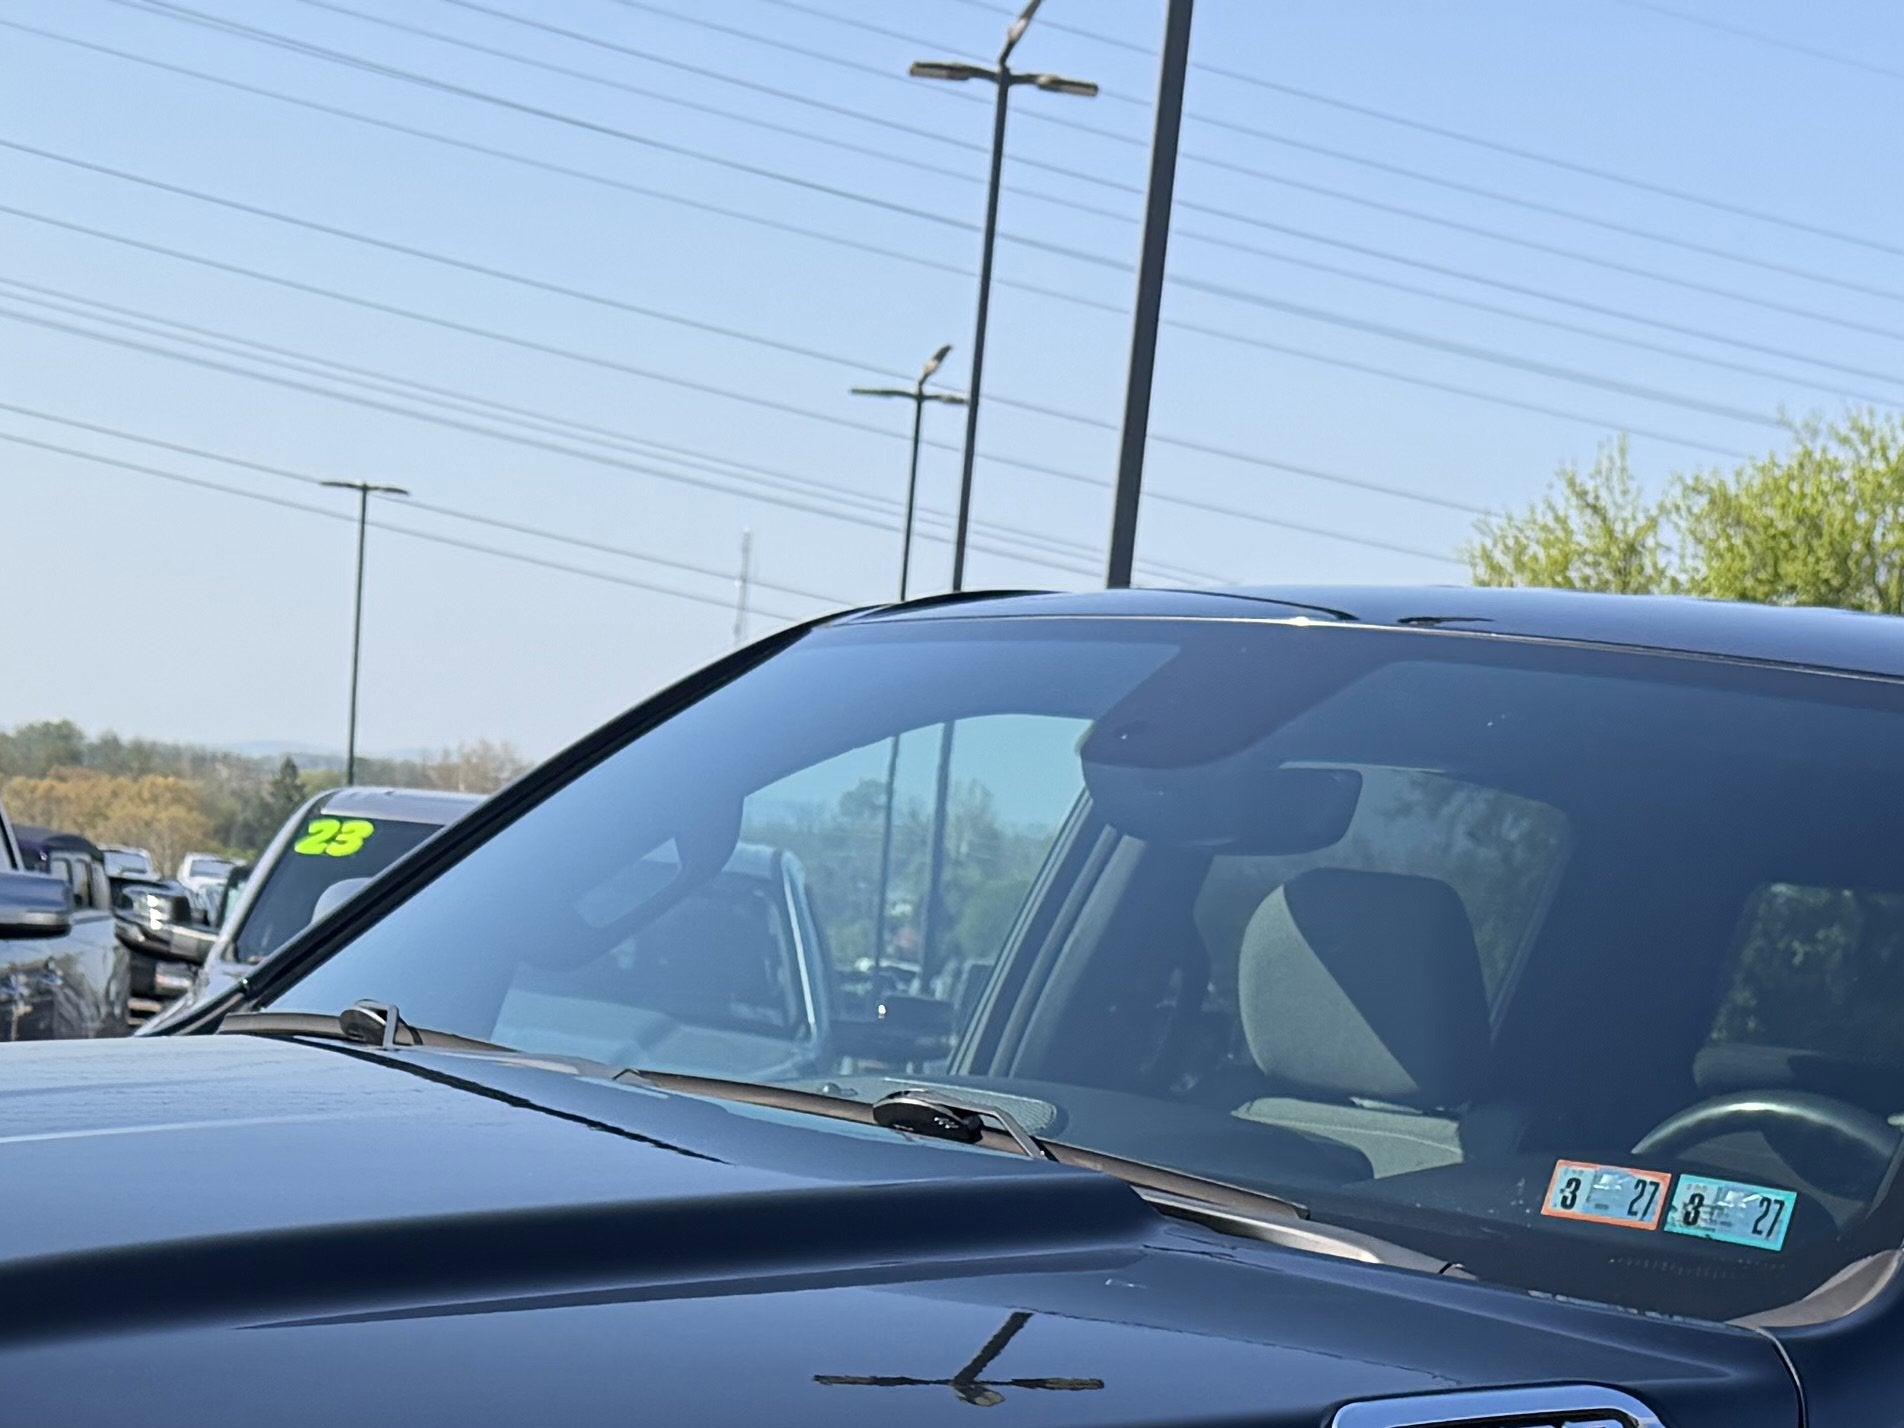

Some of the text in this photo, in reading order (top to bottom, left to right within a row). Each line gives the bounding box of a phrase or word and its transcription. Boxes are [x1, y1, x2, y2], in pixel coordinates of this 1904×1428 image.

[294, 818, 374, 857] 23
[1560, 1177, 1660, 1221] 3 27
[1752, 1196, 1785, 1239] 27
